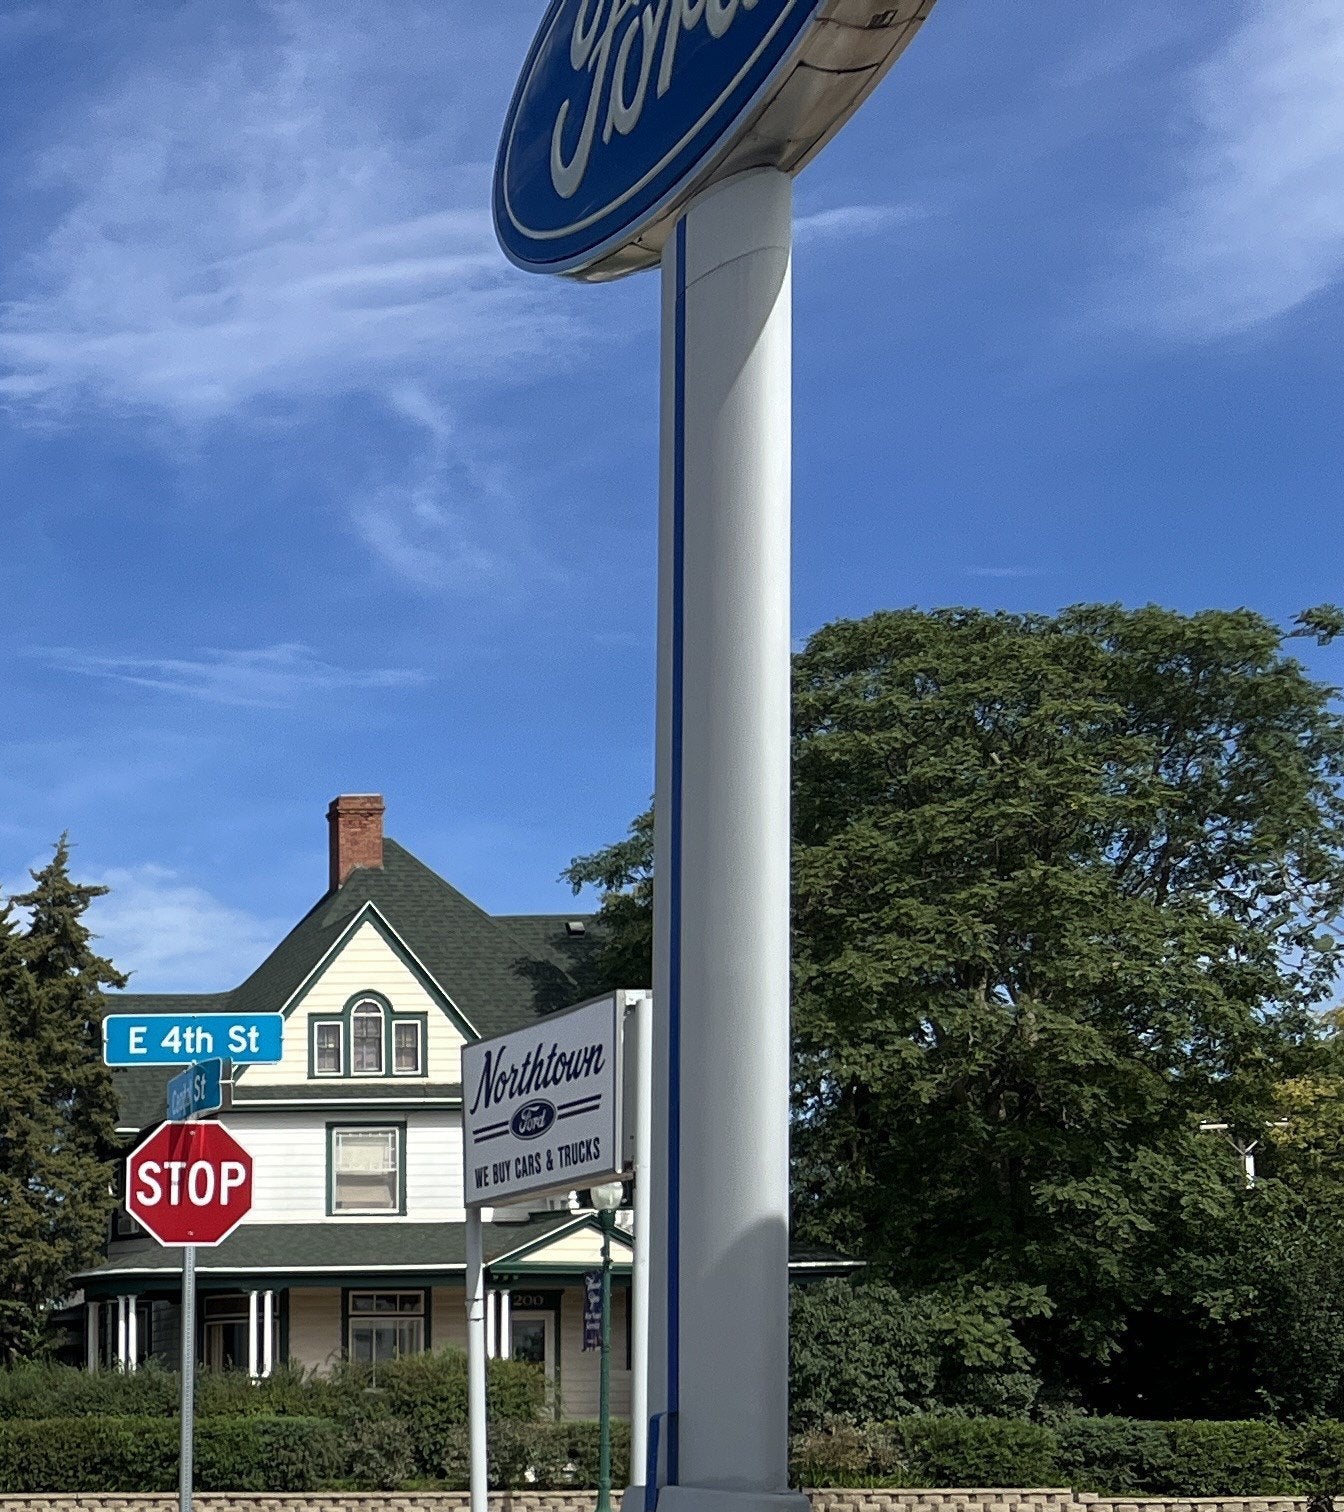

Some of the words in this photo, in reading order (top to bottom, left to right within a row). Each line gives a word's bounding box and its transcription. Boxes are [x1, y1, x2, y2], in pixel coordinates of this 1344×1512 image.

[550, 0, 759, 199] For
[129, 1026, 147, 1054] E
[160, 1025, 214, 1054] 4th
[228, 1025, 260, 1053] St
[193, 1073, 207, 1102] St
[469, 1042, 605, 1115] Northtown
[518, 1105, 548, 1134] Ford
[474, 1165, 489, 1188] WE
[492, 1160, 512, 1185] BUY
[514, 1152, 542, 1179] CARS
[546, 1149, 554, 1171] &
[557, 1137, 601, 1168] TRUCKS
[136, 1160, 246, 1207] STOP
[513, 1295, 544, 1306] 200
